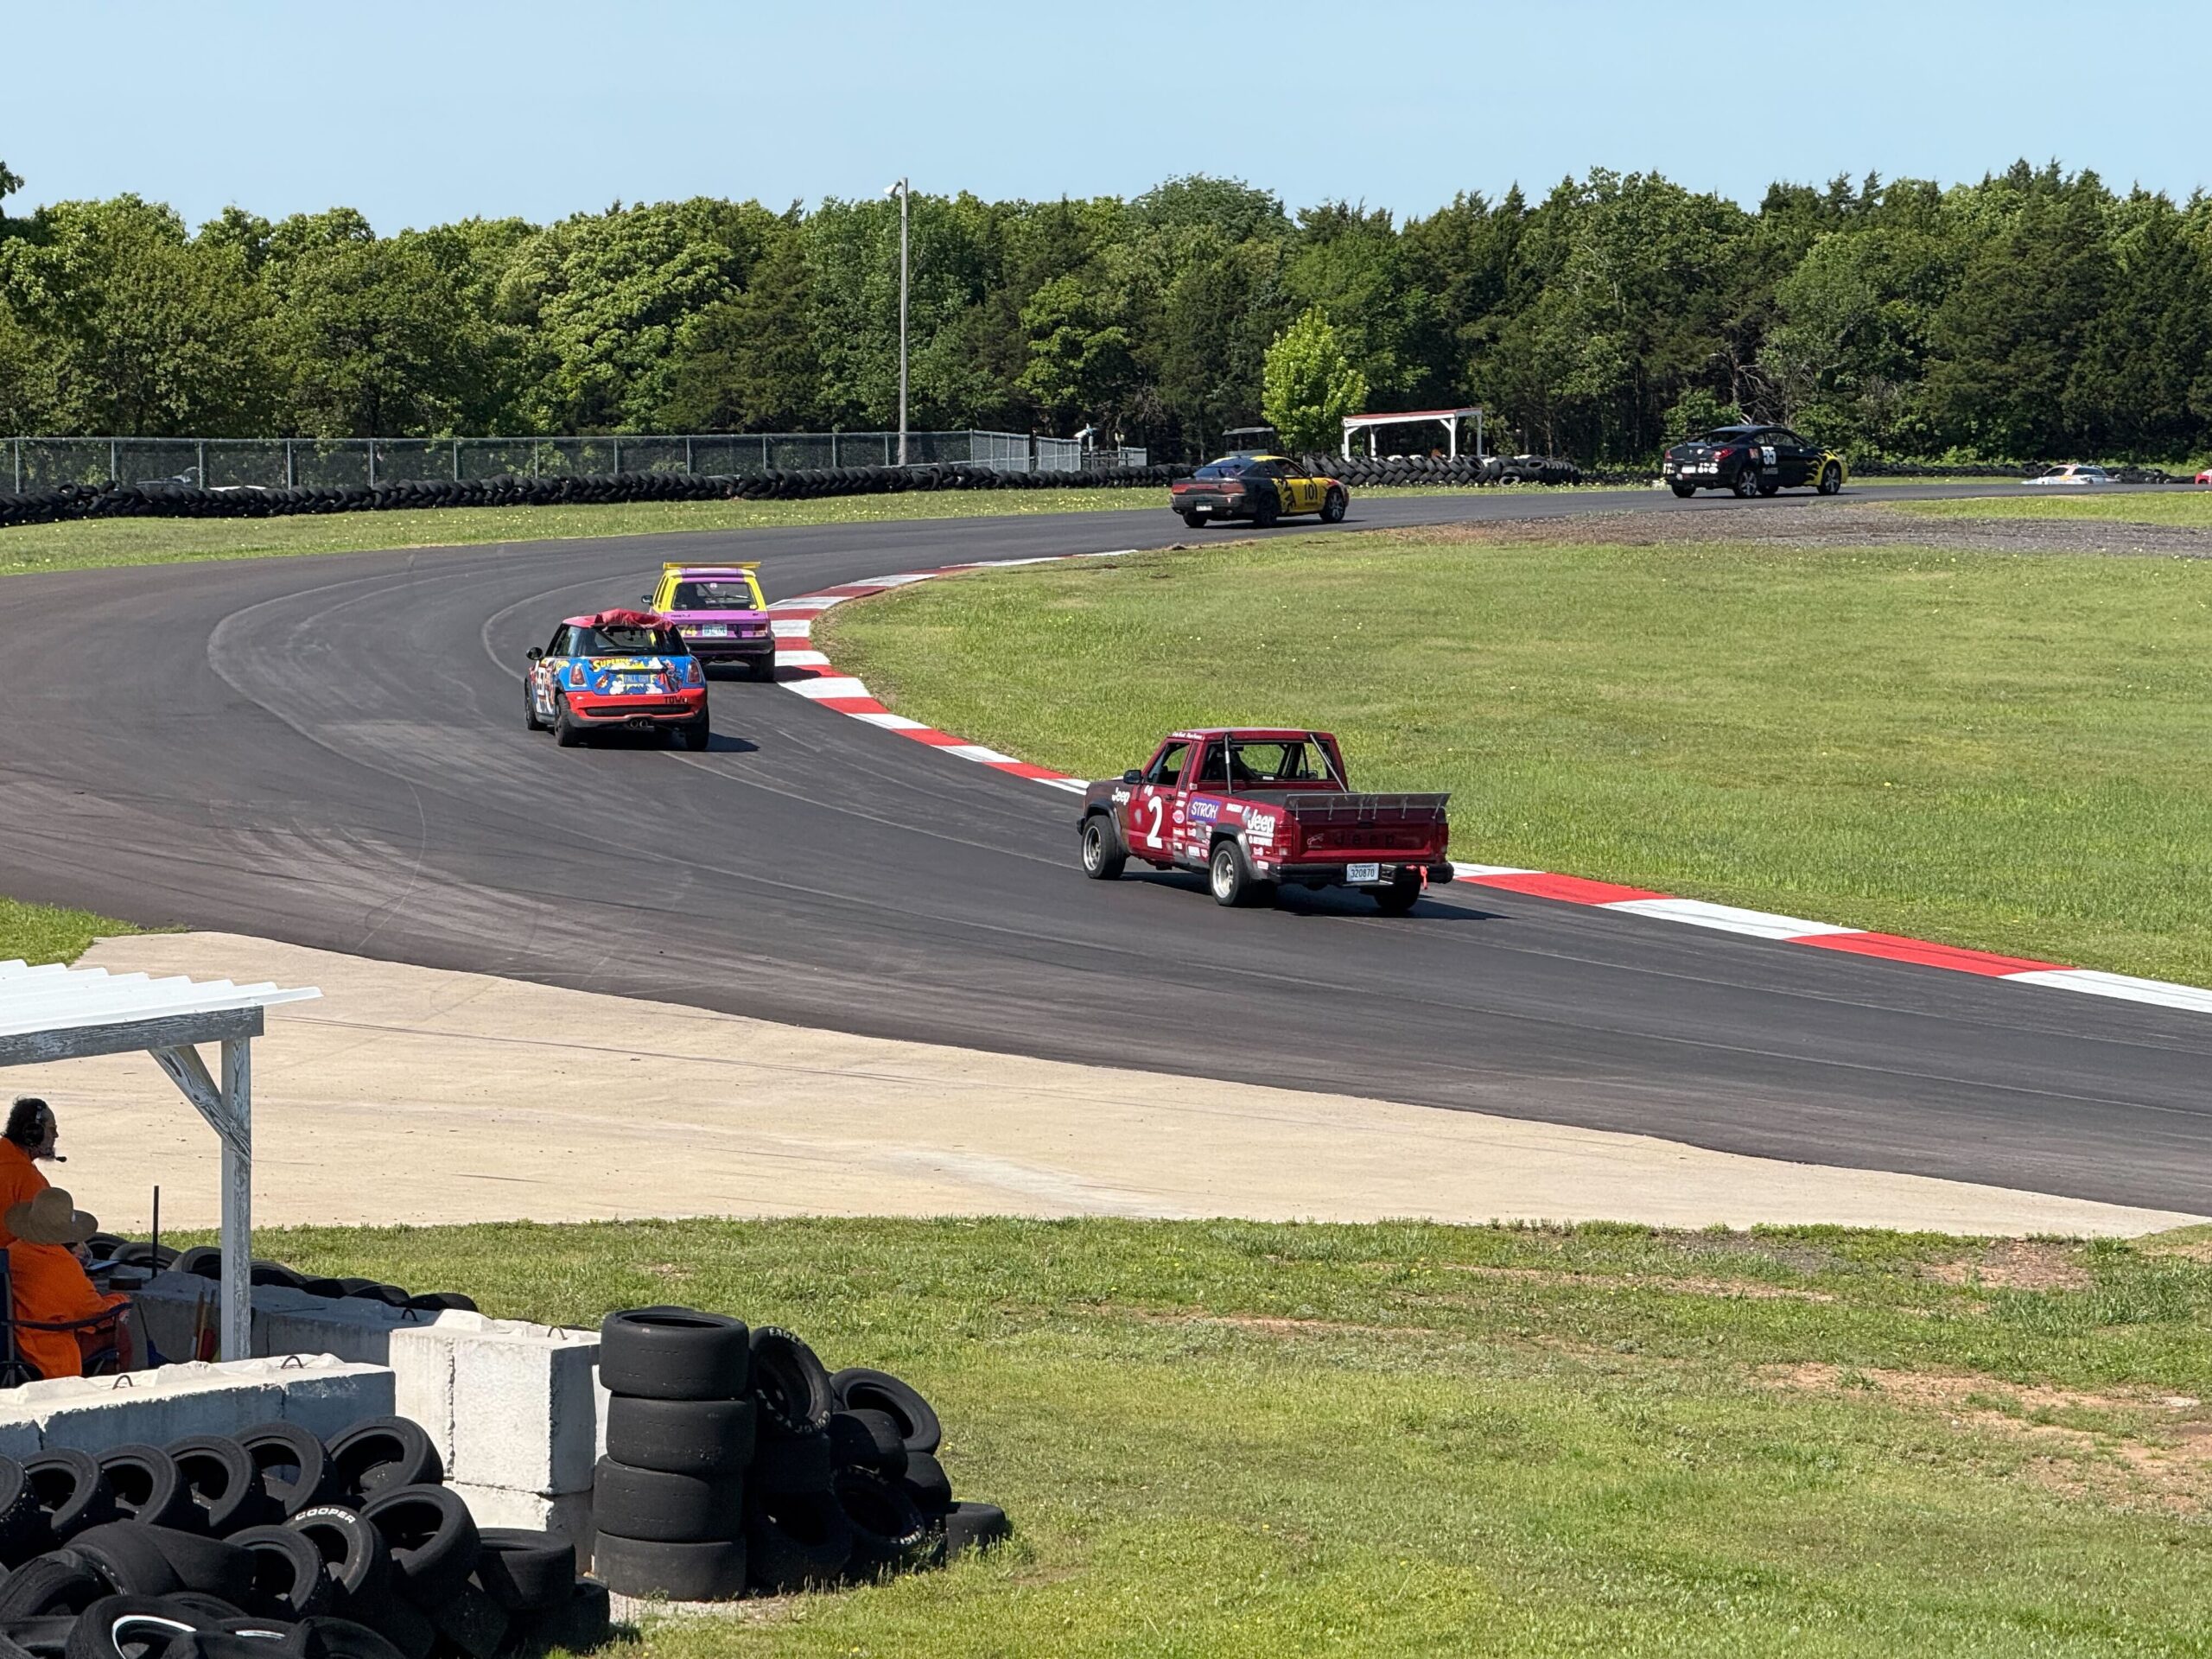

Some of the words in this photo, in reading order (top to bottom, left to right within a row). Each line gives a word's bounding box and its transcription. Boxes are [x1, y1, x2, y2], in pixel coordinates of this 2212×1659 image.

[1304, 483, 1318, 500] 101
[1112, 787, 1130, 805] Jeep
[1192, 801, 1219, 819] STROH
[1147, 796, 1162, 849] 2
[1248, 809, 1275, 834] Jeep
[1351, 868, 1375, 878] 320870
[295, 1507, 356, 1524] COOPER
